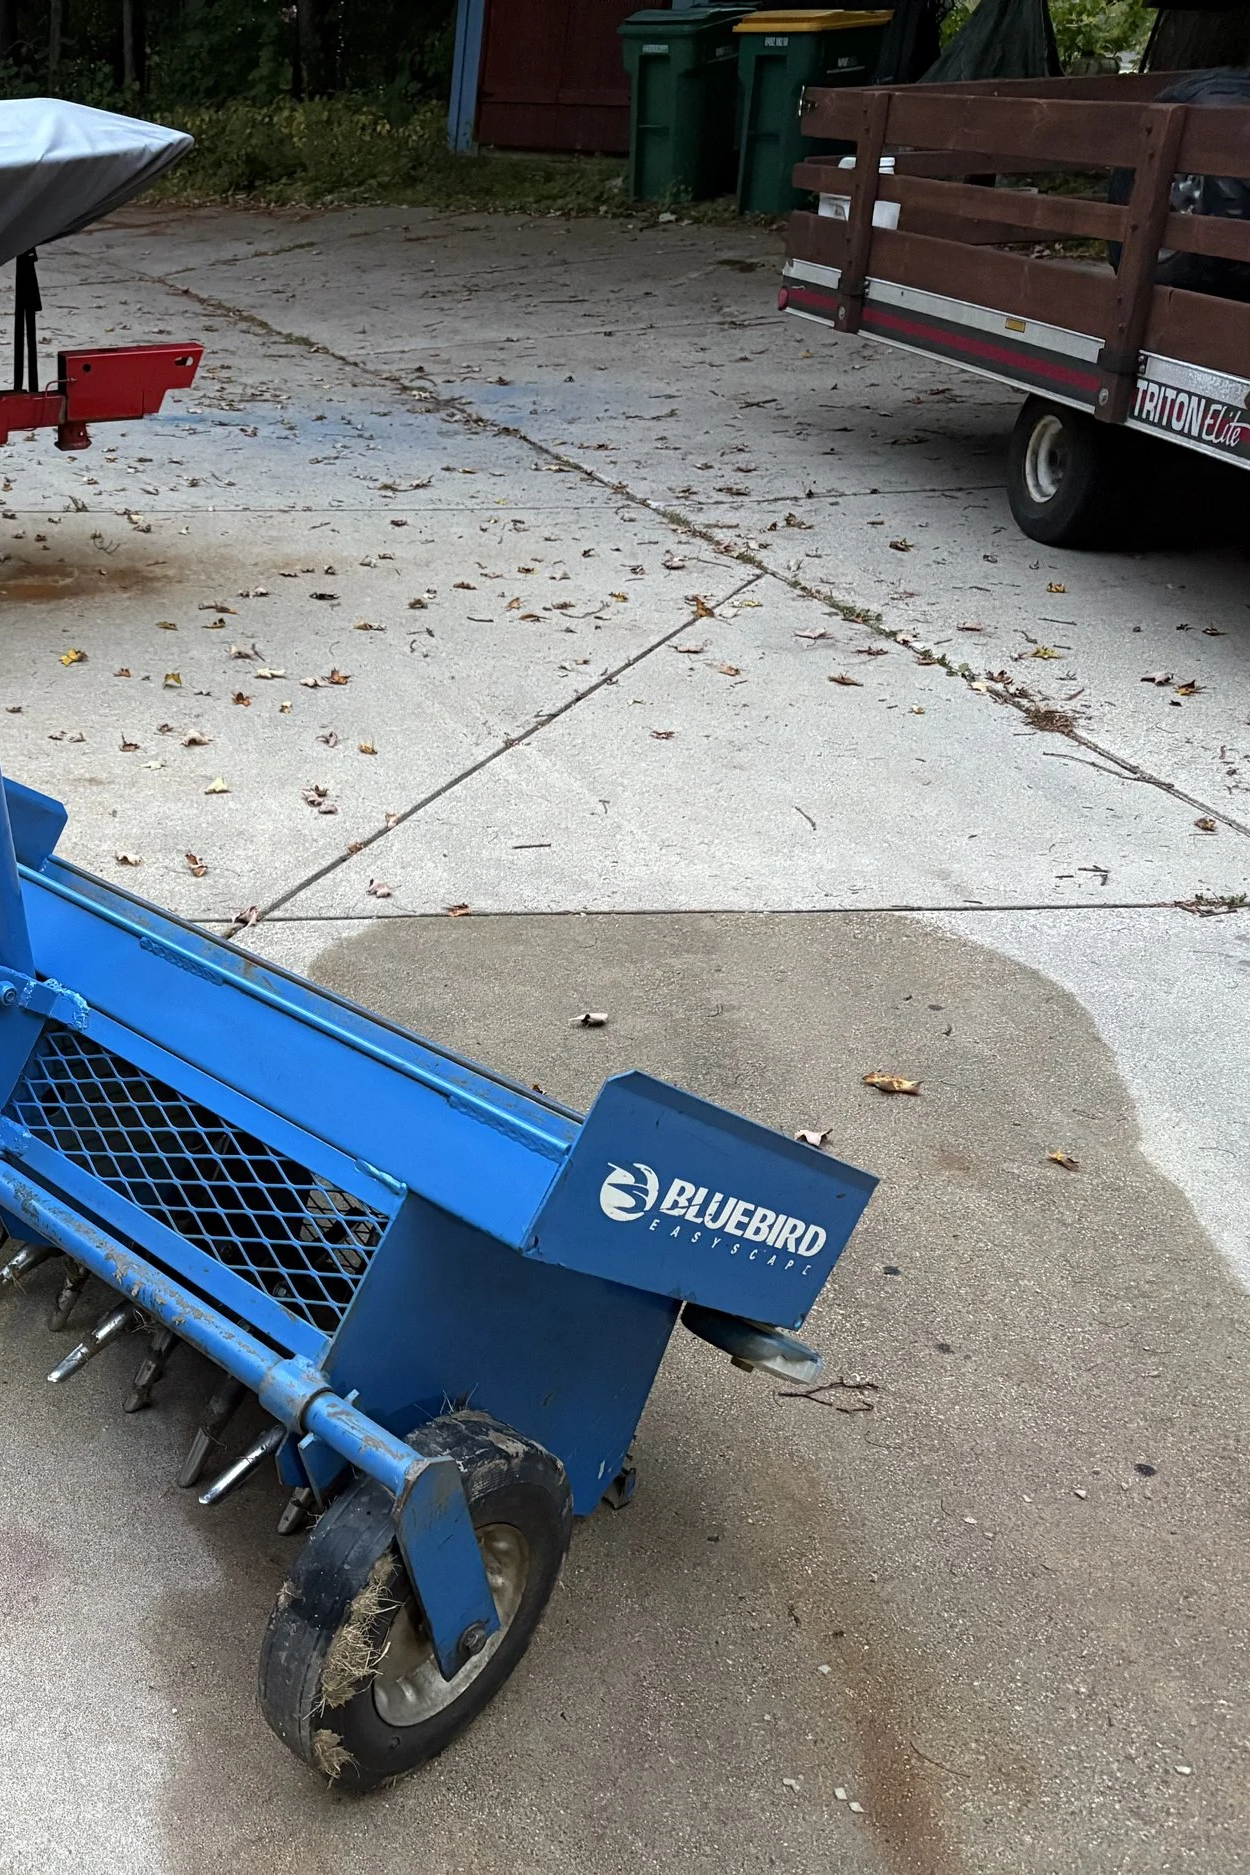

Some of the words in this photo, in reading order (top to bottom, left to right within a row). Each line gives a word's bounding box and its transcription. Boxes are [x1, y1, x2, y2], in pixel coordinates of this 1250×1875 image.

[1134, 379, 1206, 437] TRITON
[659, 1178, 827, 1257] BLUEBIRD
[649, 1219, 812, 1275] EASYSCAPE
